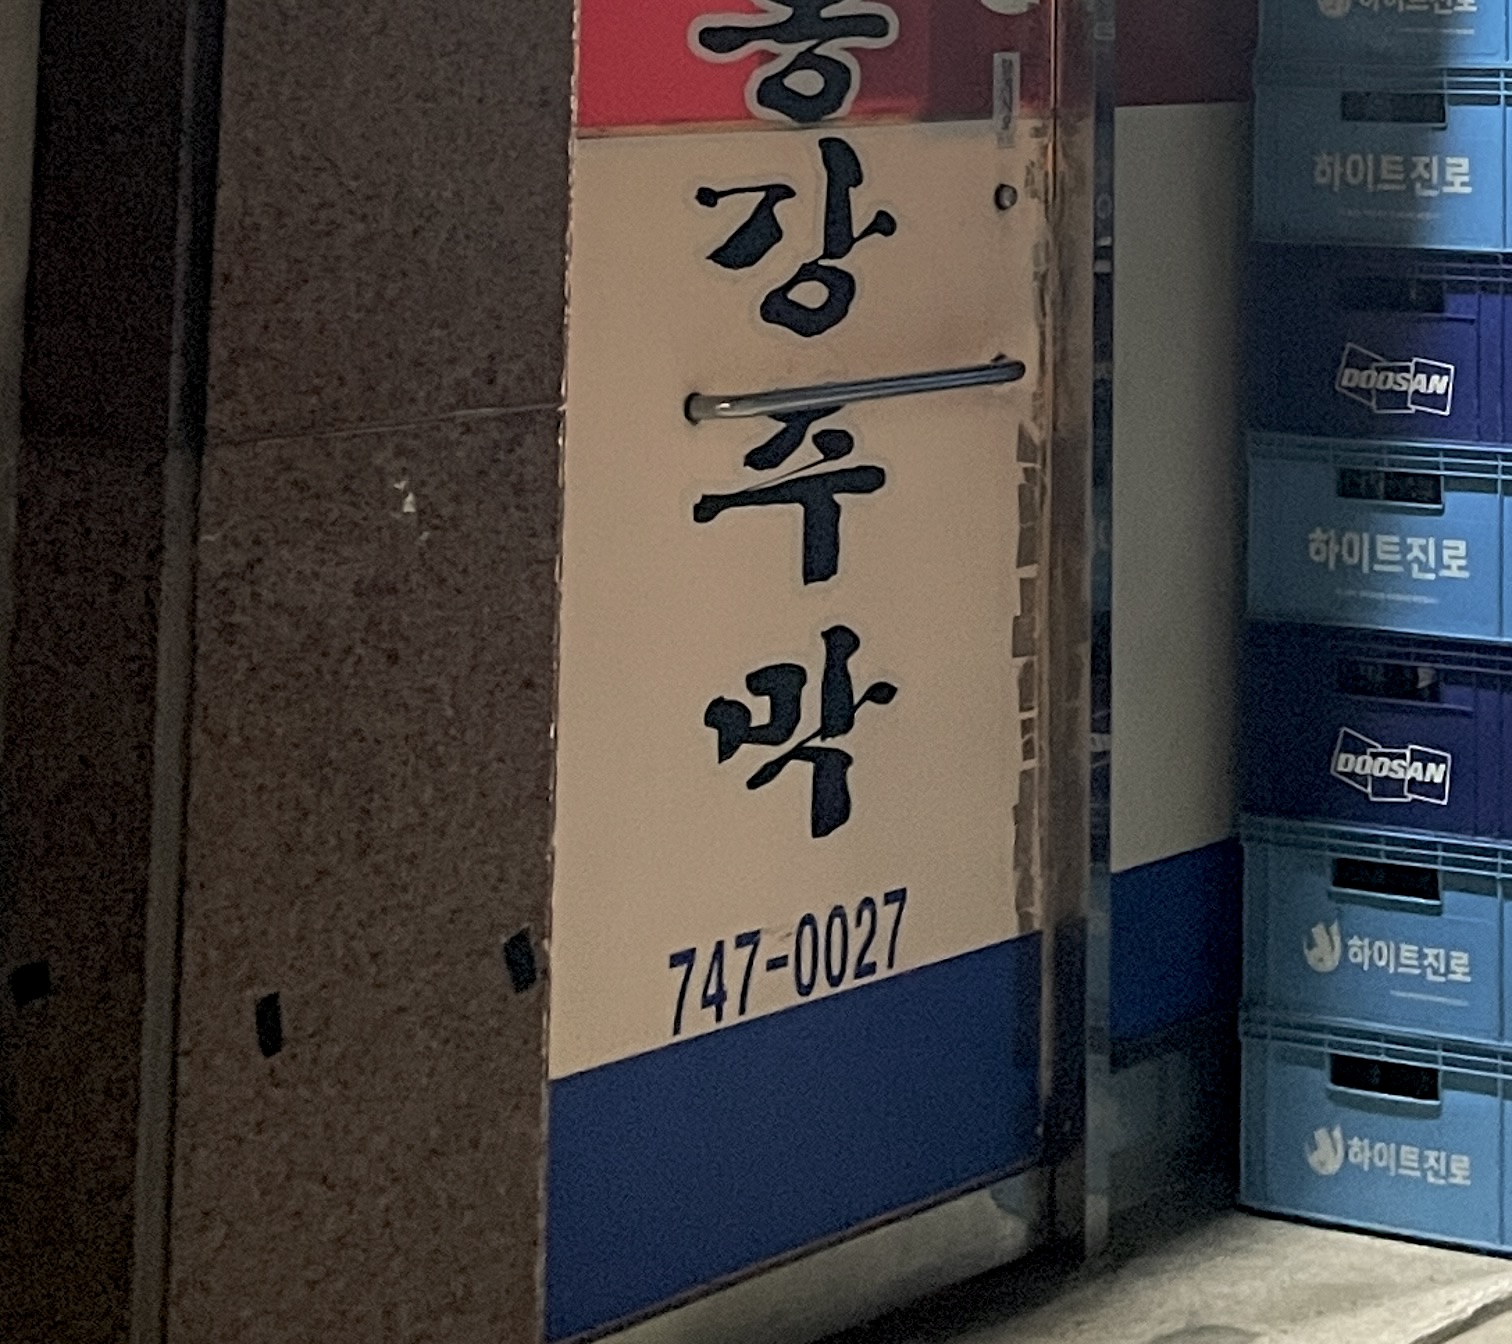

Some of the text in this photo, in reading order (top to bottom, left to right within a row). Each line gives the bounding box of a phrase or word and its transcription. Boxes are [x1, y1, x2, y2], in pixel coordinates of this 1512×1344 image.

[1313, 152, 1473, 198] 하이트진로
[1340, 367, 1449, 396] DOOSAN
[1308, 526, 1471, 582] 하이트진로
[1335, 751, 1447, 786] DOOSAN
[668, 887, 908, 1036] 747-0027
[1347, 933, 1472, 984] 하이트진로
[1347, 1136, 1472, 1187] 하이트진로
